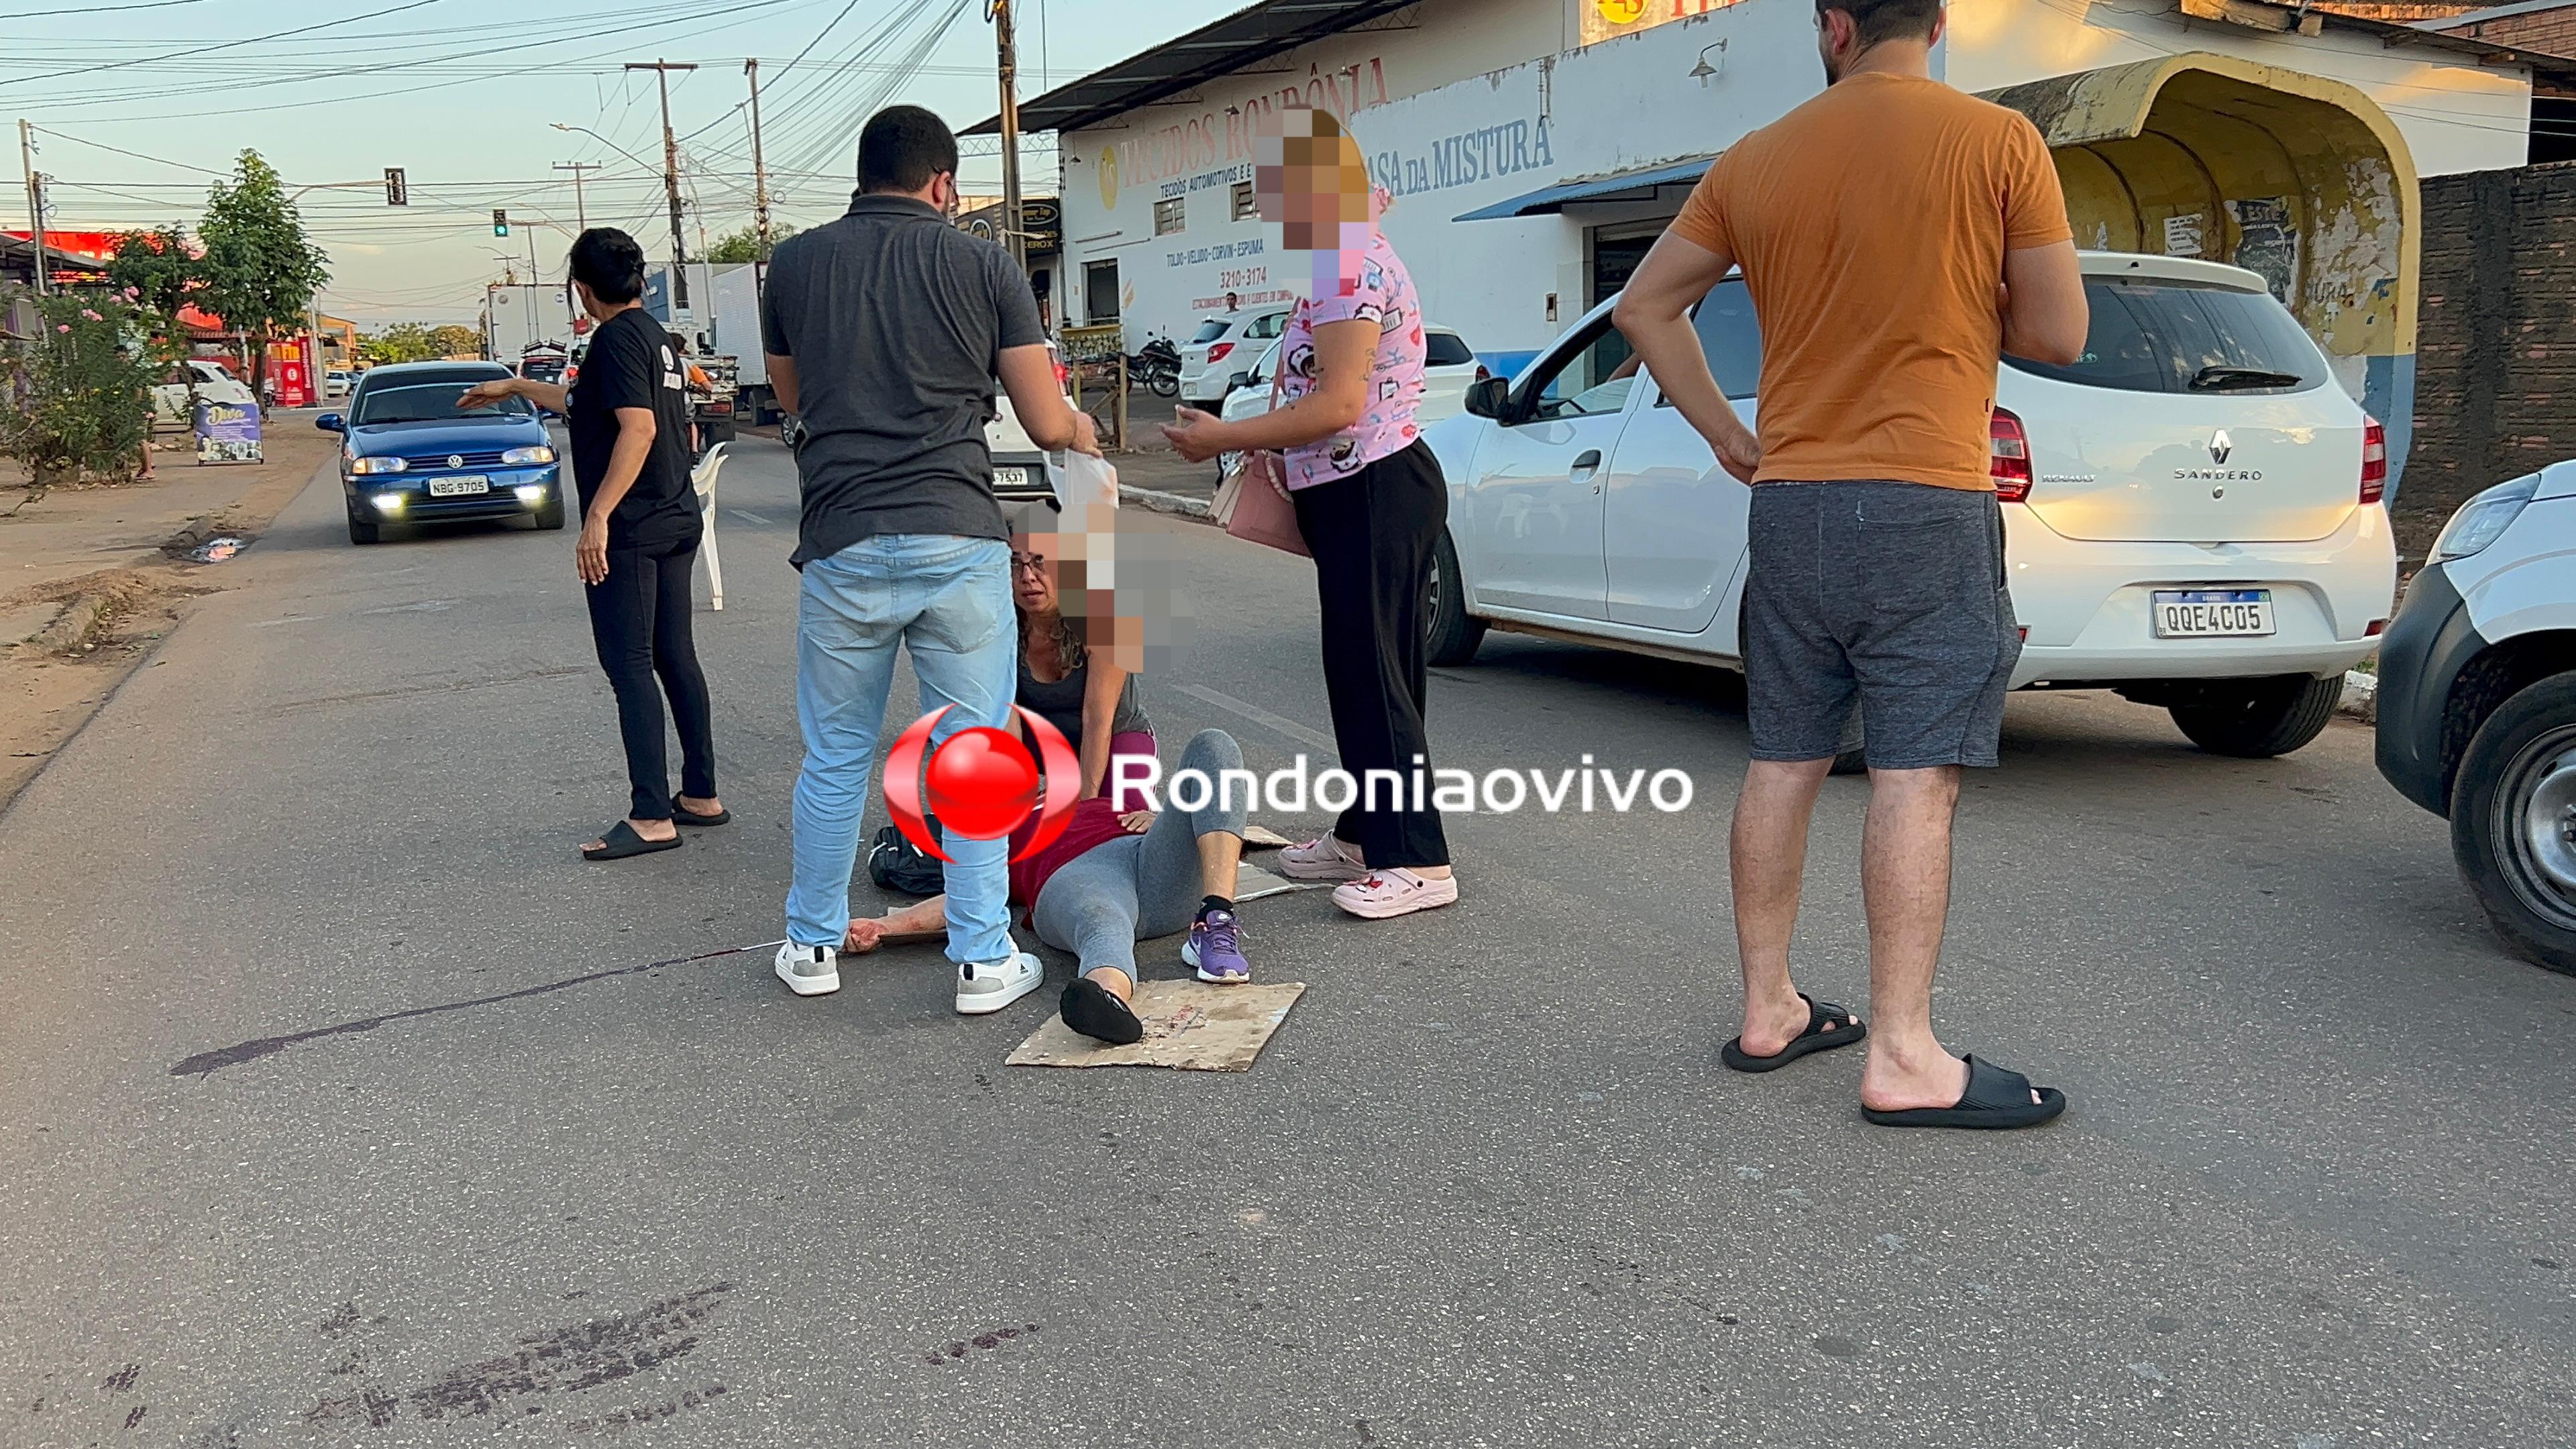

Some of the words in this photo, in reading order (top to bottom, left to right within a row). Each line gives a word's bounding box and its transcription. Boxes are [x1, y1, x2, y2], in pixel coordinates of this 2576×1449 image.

[1367, 150, 1404, 197] ASA
[1405, 157, 1430, 195] DA
[1432, 117, 1554, 189] MISTURA
[1161, 178, 1186, 199] TECIDOS
[1189, 166, 1237, 192] AUTOMOTIVOS
[1220, 266, 1267, 288] 3210-3174
[2042, 474, 2096, 483] RENAULT
[2174, 468, 2263, 480] SANDERO
[2166, 605, 2261, 631] QQE4C05
